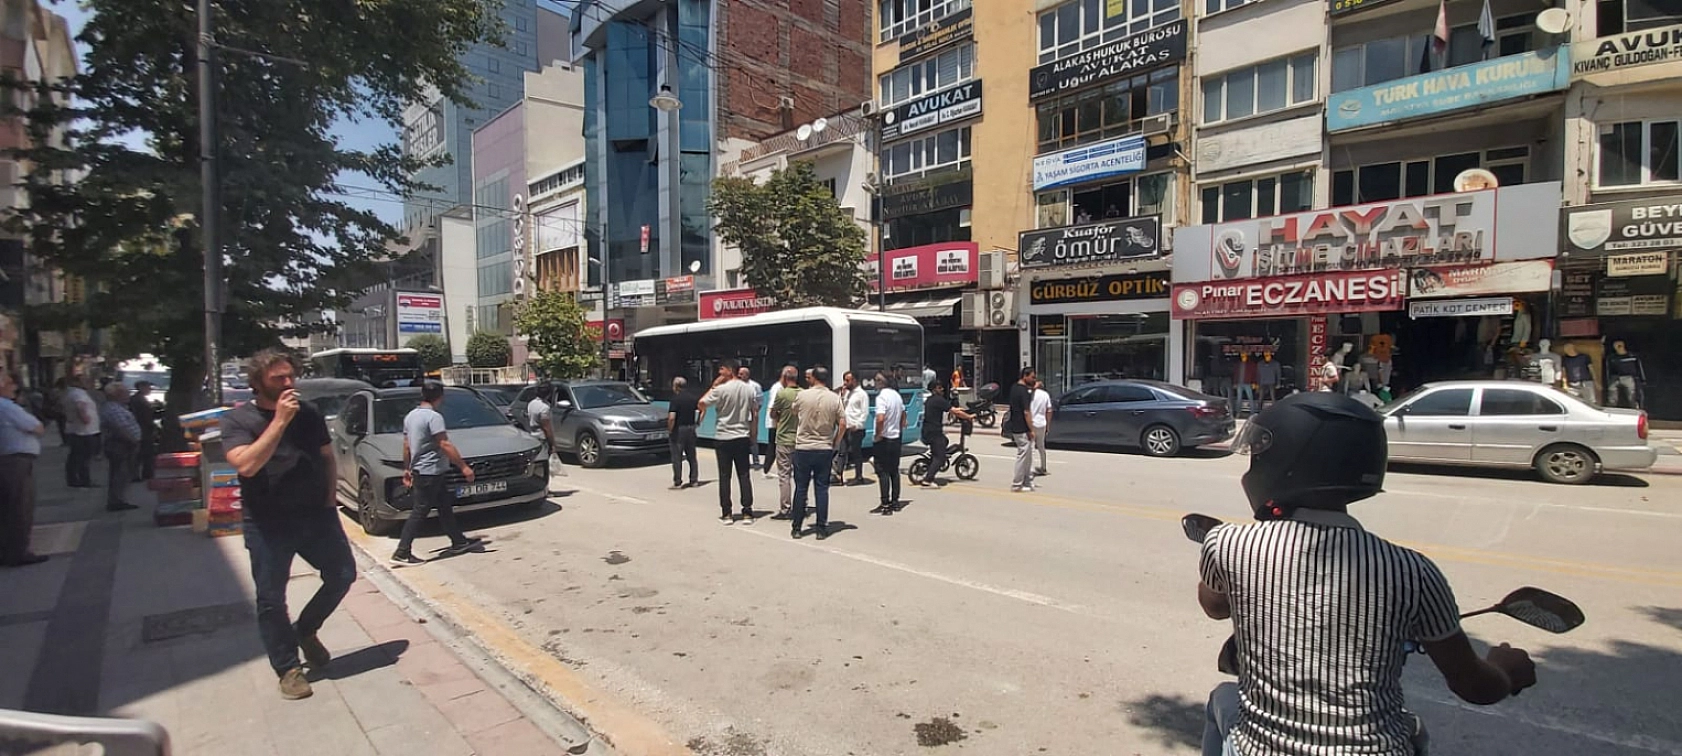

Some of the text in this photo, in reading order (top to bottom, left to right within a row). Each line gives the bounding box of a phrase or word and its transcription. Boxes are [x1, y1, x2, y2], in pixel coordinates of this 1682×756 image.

[1053, 52, 1092, 74] ALAKAŞ
[1093, 39, 1132, 62] HUKUK
[1080, 45, 1150, 73] AVUKAT
[1423, 72, 1471, 95] HAVA
[908, 84, 973, 117] AVUKAT
[1044, 167, 1068, 180] YAŞAM
[1069, 161, 1099, 175] SİGORTA
[1258, 195, 1475, 245] HAYAT
[1613, 254, 1662, 265] MARATON
[1032, 275, 1165, 300] GÜRBÜZ OPTİK
[1202, 285, 1244, 298] Pınar
[1413, 302, 1438, 314] PATİK
[1465, 302, 1507, 312] CENTER
